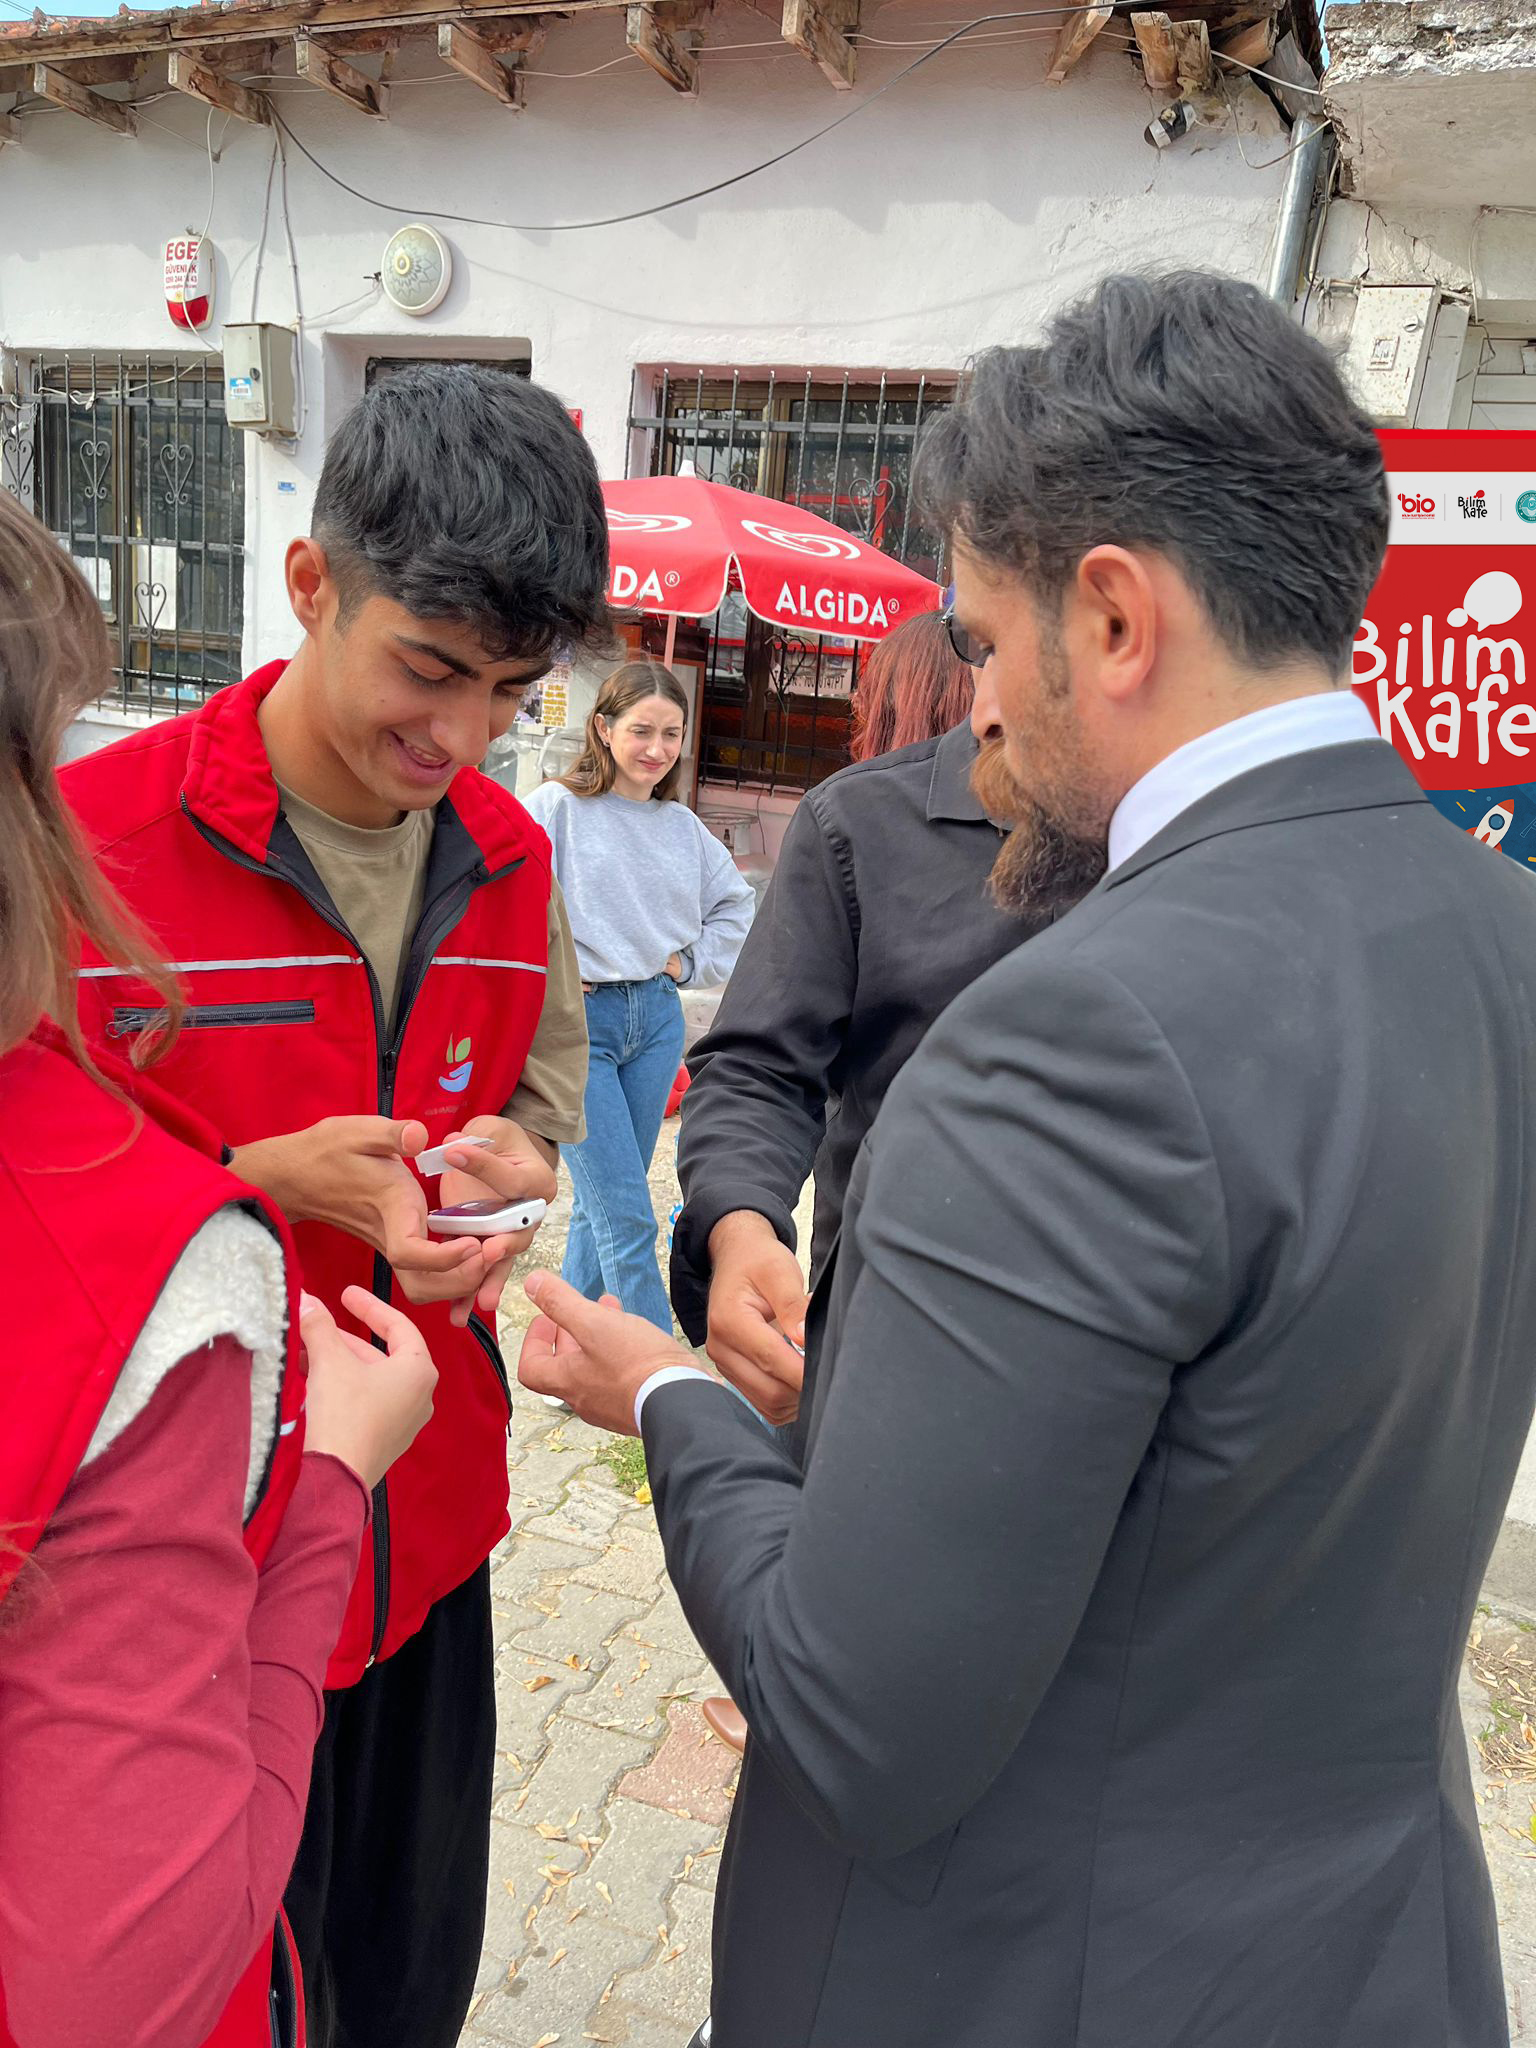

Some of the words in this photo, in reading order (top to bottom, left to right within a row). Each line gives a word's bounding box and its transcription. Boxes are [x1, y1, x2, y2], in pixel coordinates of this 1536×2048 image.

[166, 241, 199, 261] EGE
[1398, 493, 1436, 513] bio
[1457, 495, 1486, 508] Bilim
[1463, 505, 1488, 519] Kafe
[1351, 608, 1526, 690] Bilim
[1377, 673, 1536, 765] Kafe
